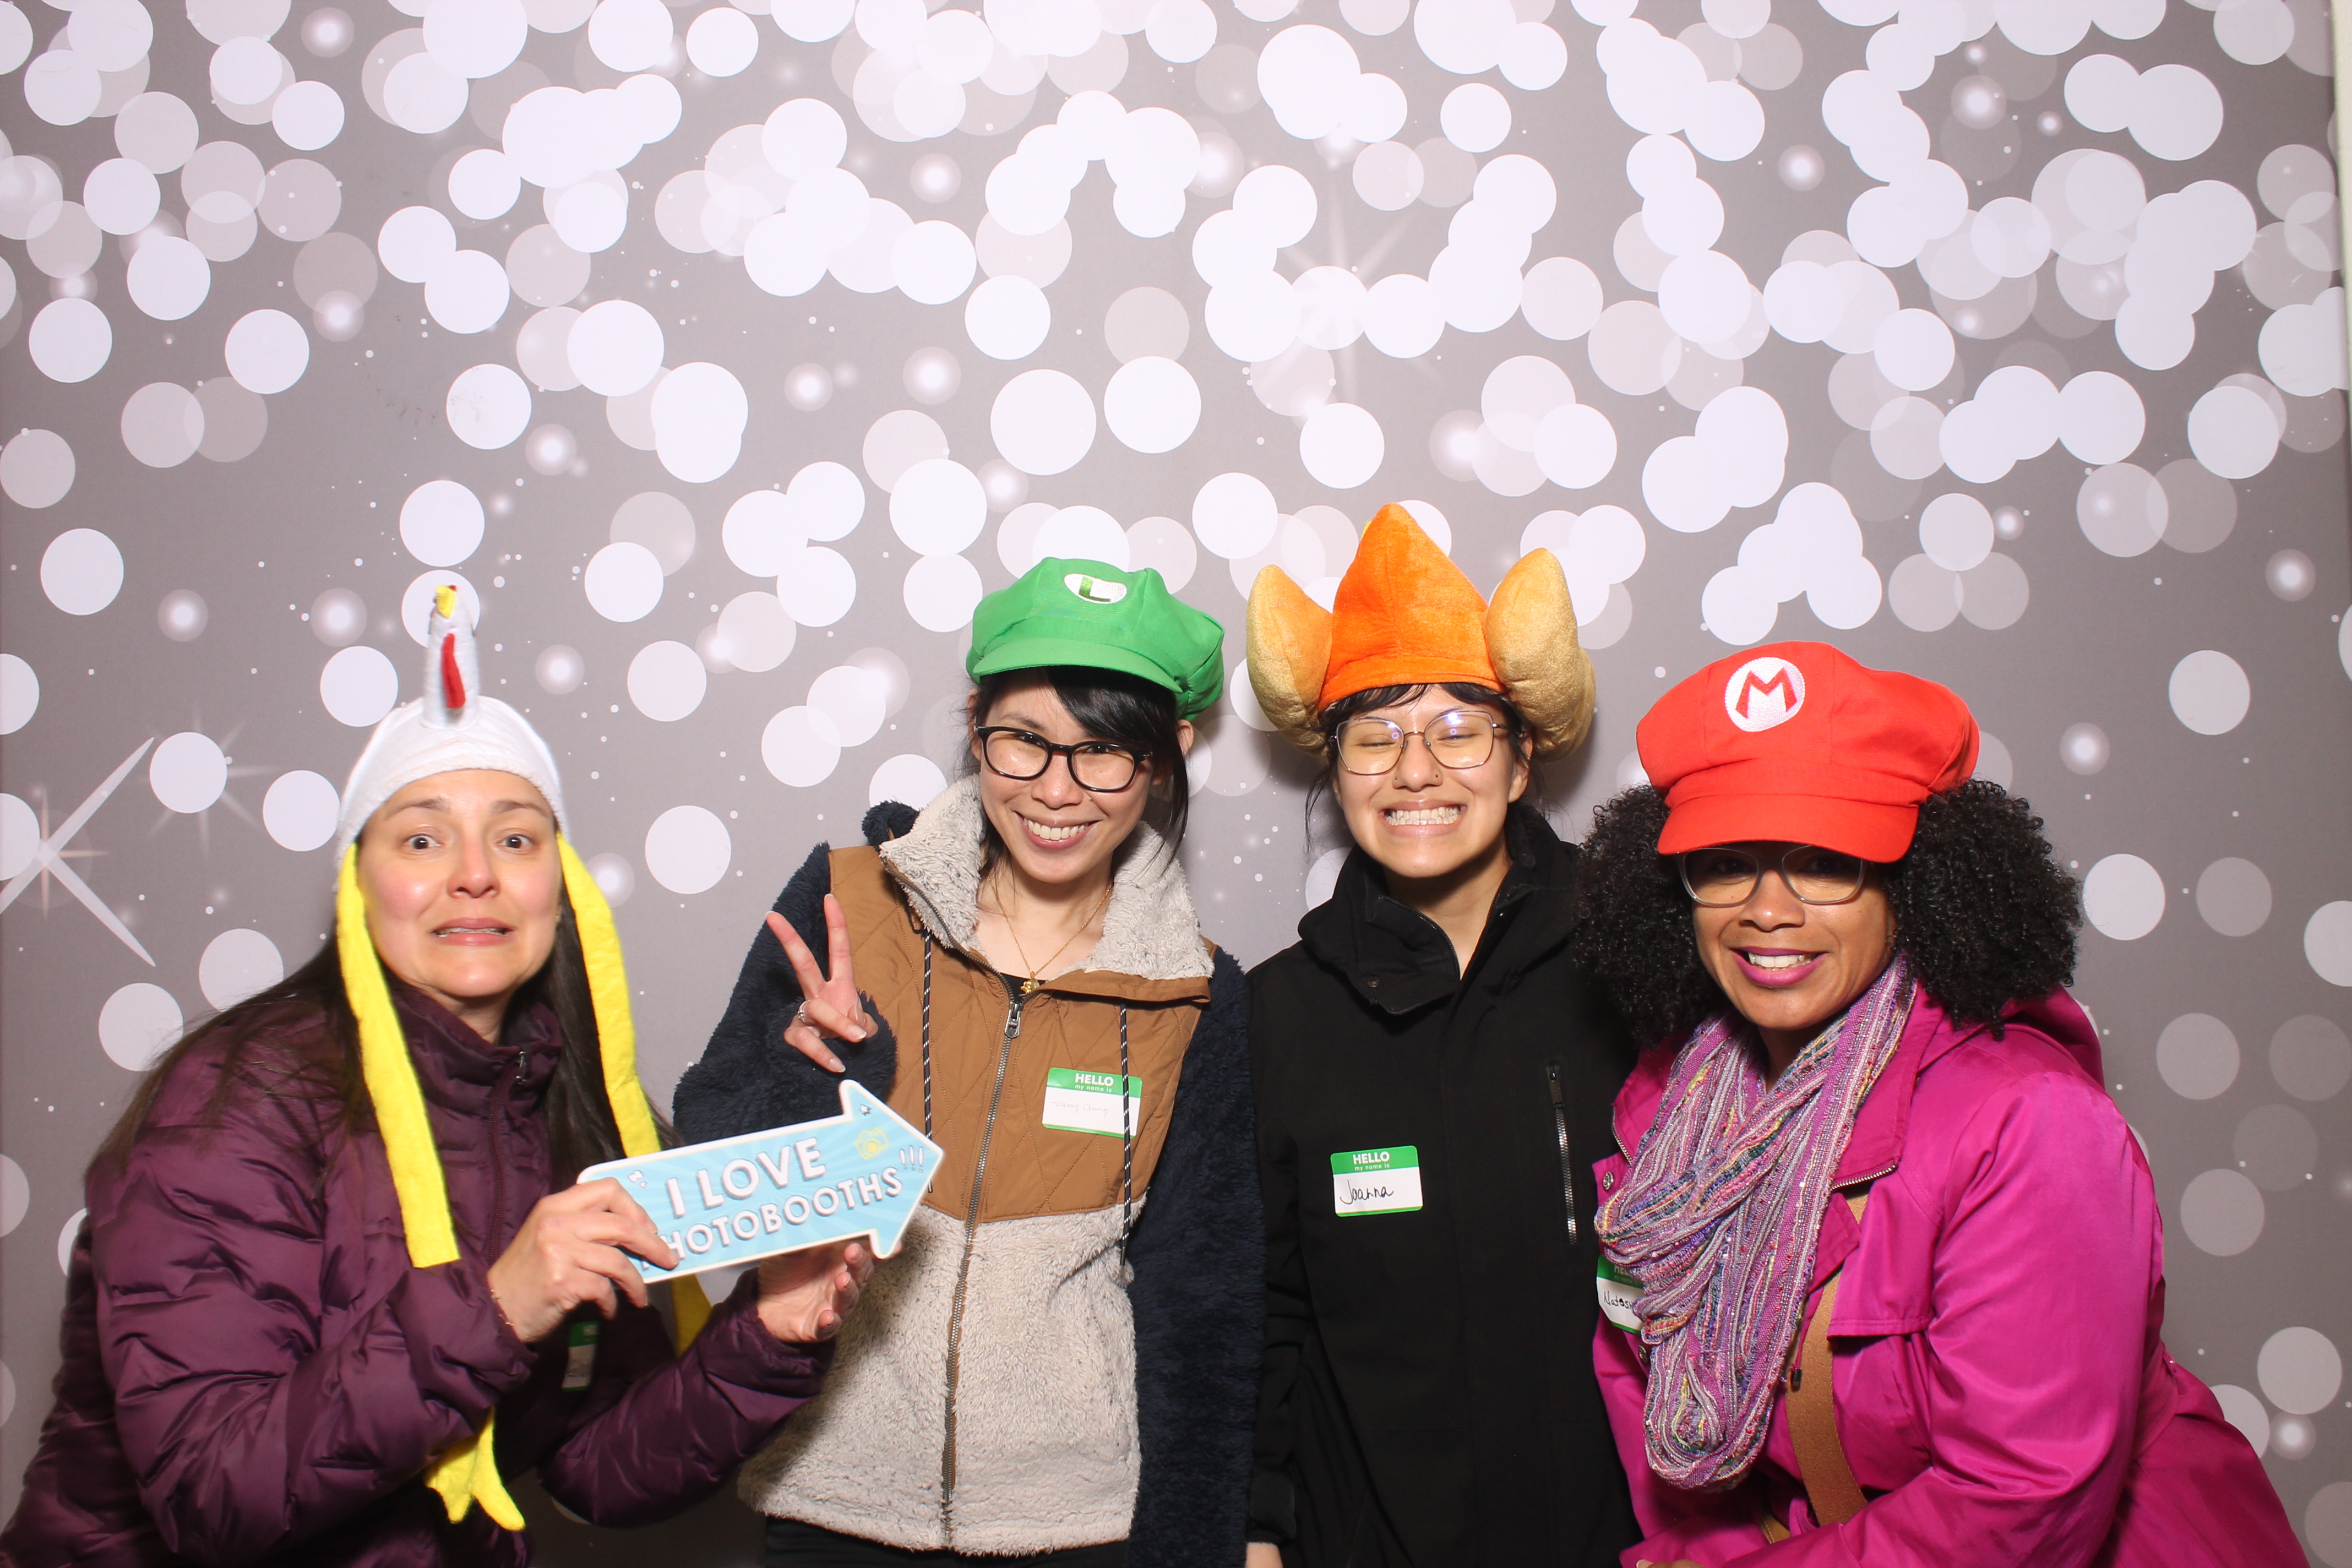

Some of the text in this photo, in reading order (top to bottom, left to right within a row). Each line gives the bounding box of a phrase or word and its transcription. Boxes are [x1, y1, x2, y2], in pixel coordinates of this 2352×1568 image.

[1078, 576, 1111, 602] L
[1735, 667, 1798, 720] M
[1075, 1073, 1114, 1086] HELLO
[1353, 1151, 1390, 1164] HELLO
[665, 1136, 826, 1219] I LOVE
[1340, 1179, 1395, 1205] Joanna
[641, 1166, 903, 1270] HOTOBOOTHS
